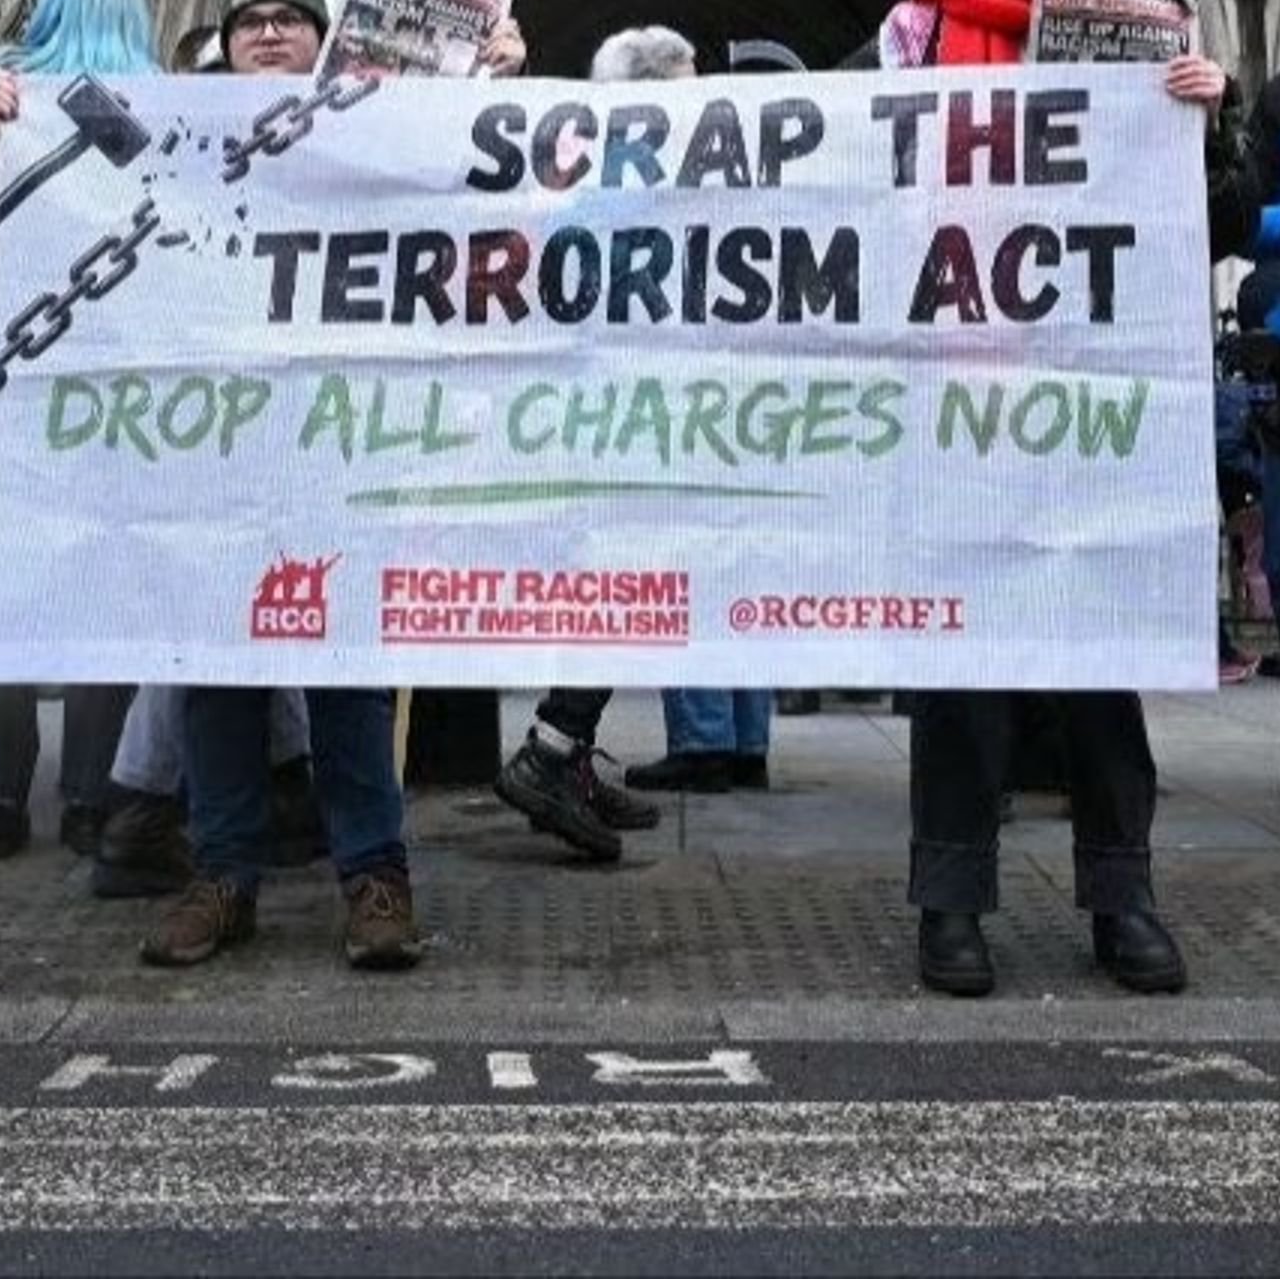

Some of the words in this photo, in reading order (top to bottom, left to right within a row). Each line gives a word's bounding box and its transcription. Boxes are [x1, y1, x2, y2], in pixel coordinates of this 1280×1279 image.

[466, 100, 825, 193] SCRAP
[872, 89, 1090, 188] THE
[253, 224, 860, 326] TERRORISM
[908, 223, 1135, 324] ACT
[46, 373, 270, 461] DROP
[296, 374, 477, 461] ALL
[507, 376, 906, 468] CHARGES
[936, 377, 1150, 460] NOW
[382, 570, 505, 604] FIGHT
[515, 570, 689, 605] RACISM!
[256, 608, 324, 634] RCG
[382, 608, 472, 634] FIGHT
[477, 608, 689, 636] IMPERIALISM!
[728, 595, 964, 632] @RCGFRFI
